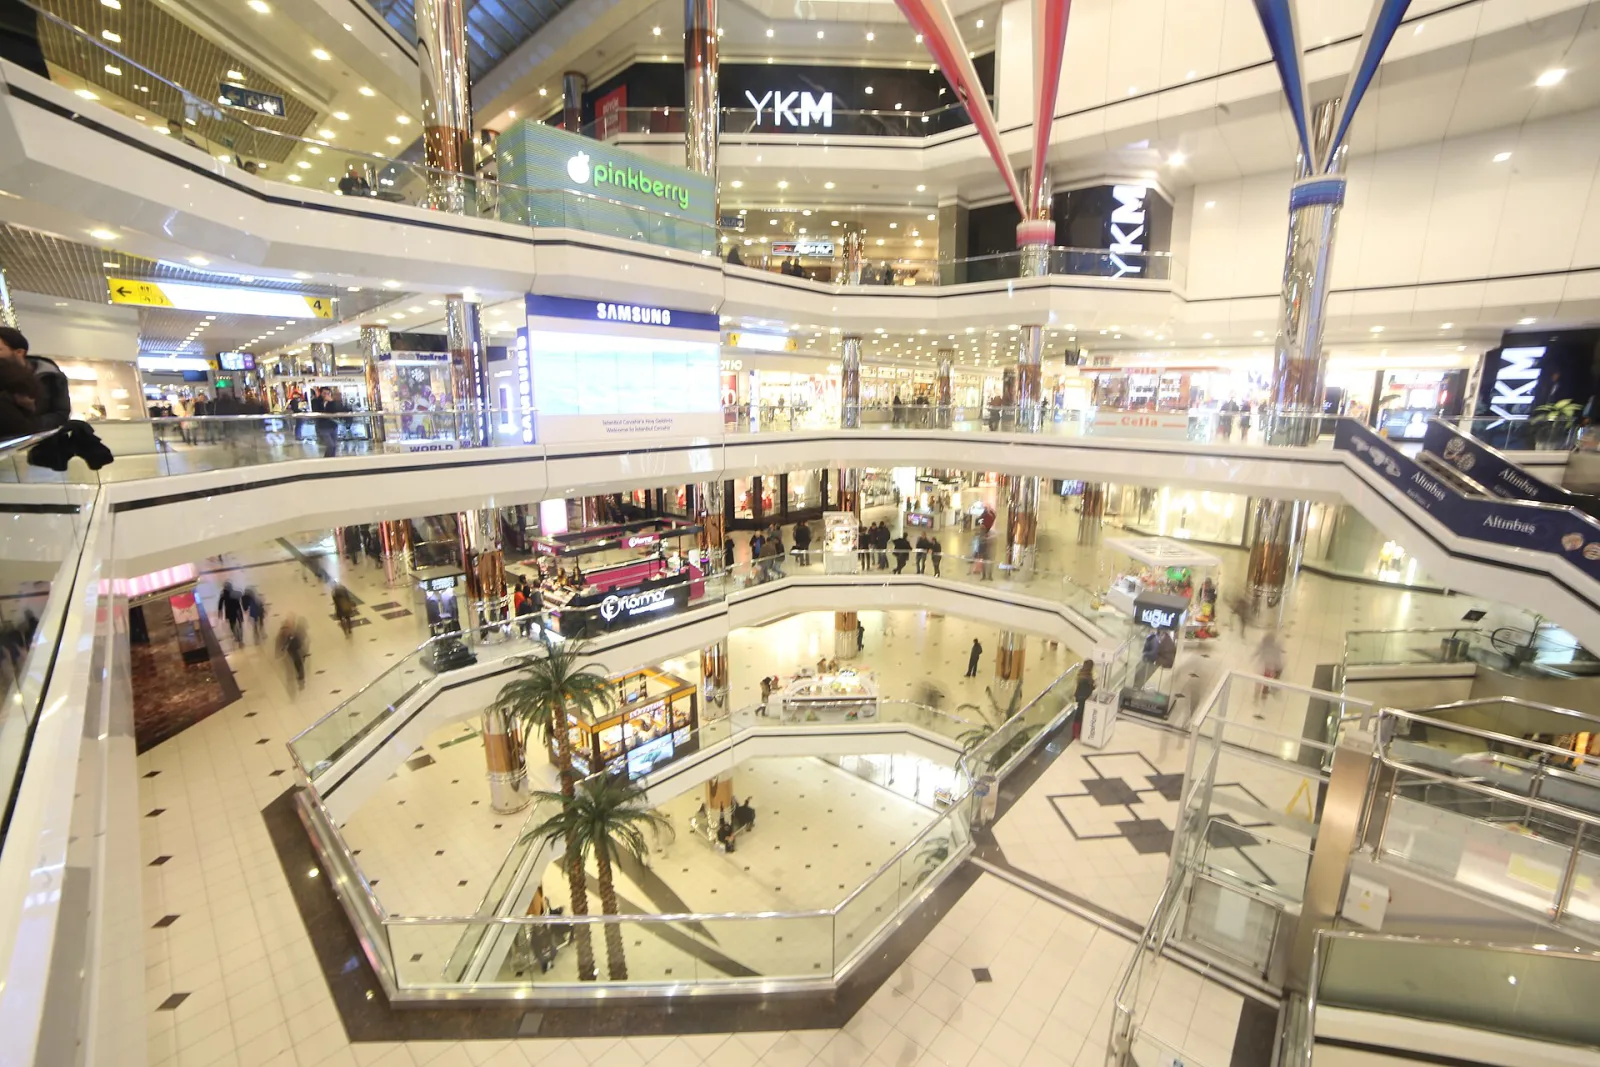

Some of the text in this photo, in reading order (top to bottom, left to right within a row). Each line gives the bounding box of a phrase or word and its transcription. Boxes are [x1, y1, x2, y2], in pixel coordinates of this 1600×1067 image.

[745, 90, 833, 127] YKM
[593, 162, 689, 209] pinkberry
[1109, 185, 1148, 280] YKM
[597, 302, 671, 325] SAMSUNG
[1486, 346, 1547, 431] YKM
[409, 444, 454, 453] WORLD
[1410, 470, 1446, 502] Altınbaş
[1482, 513, 1537, 536] Altınbaş
